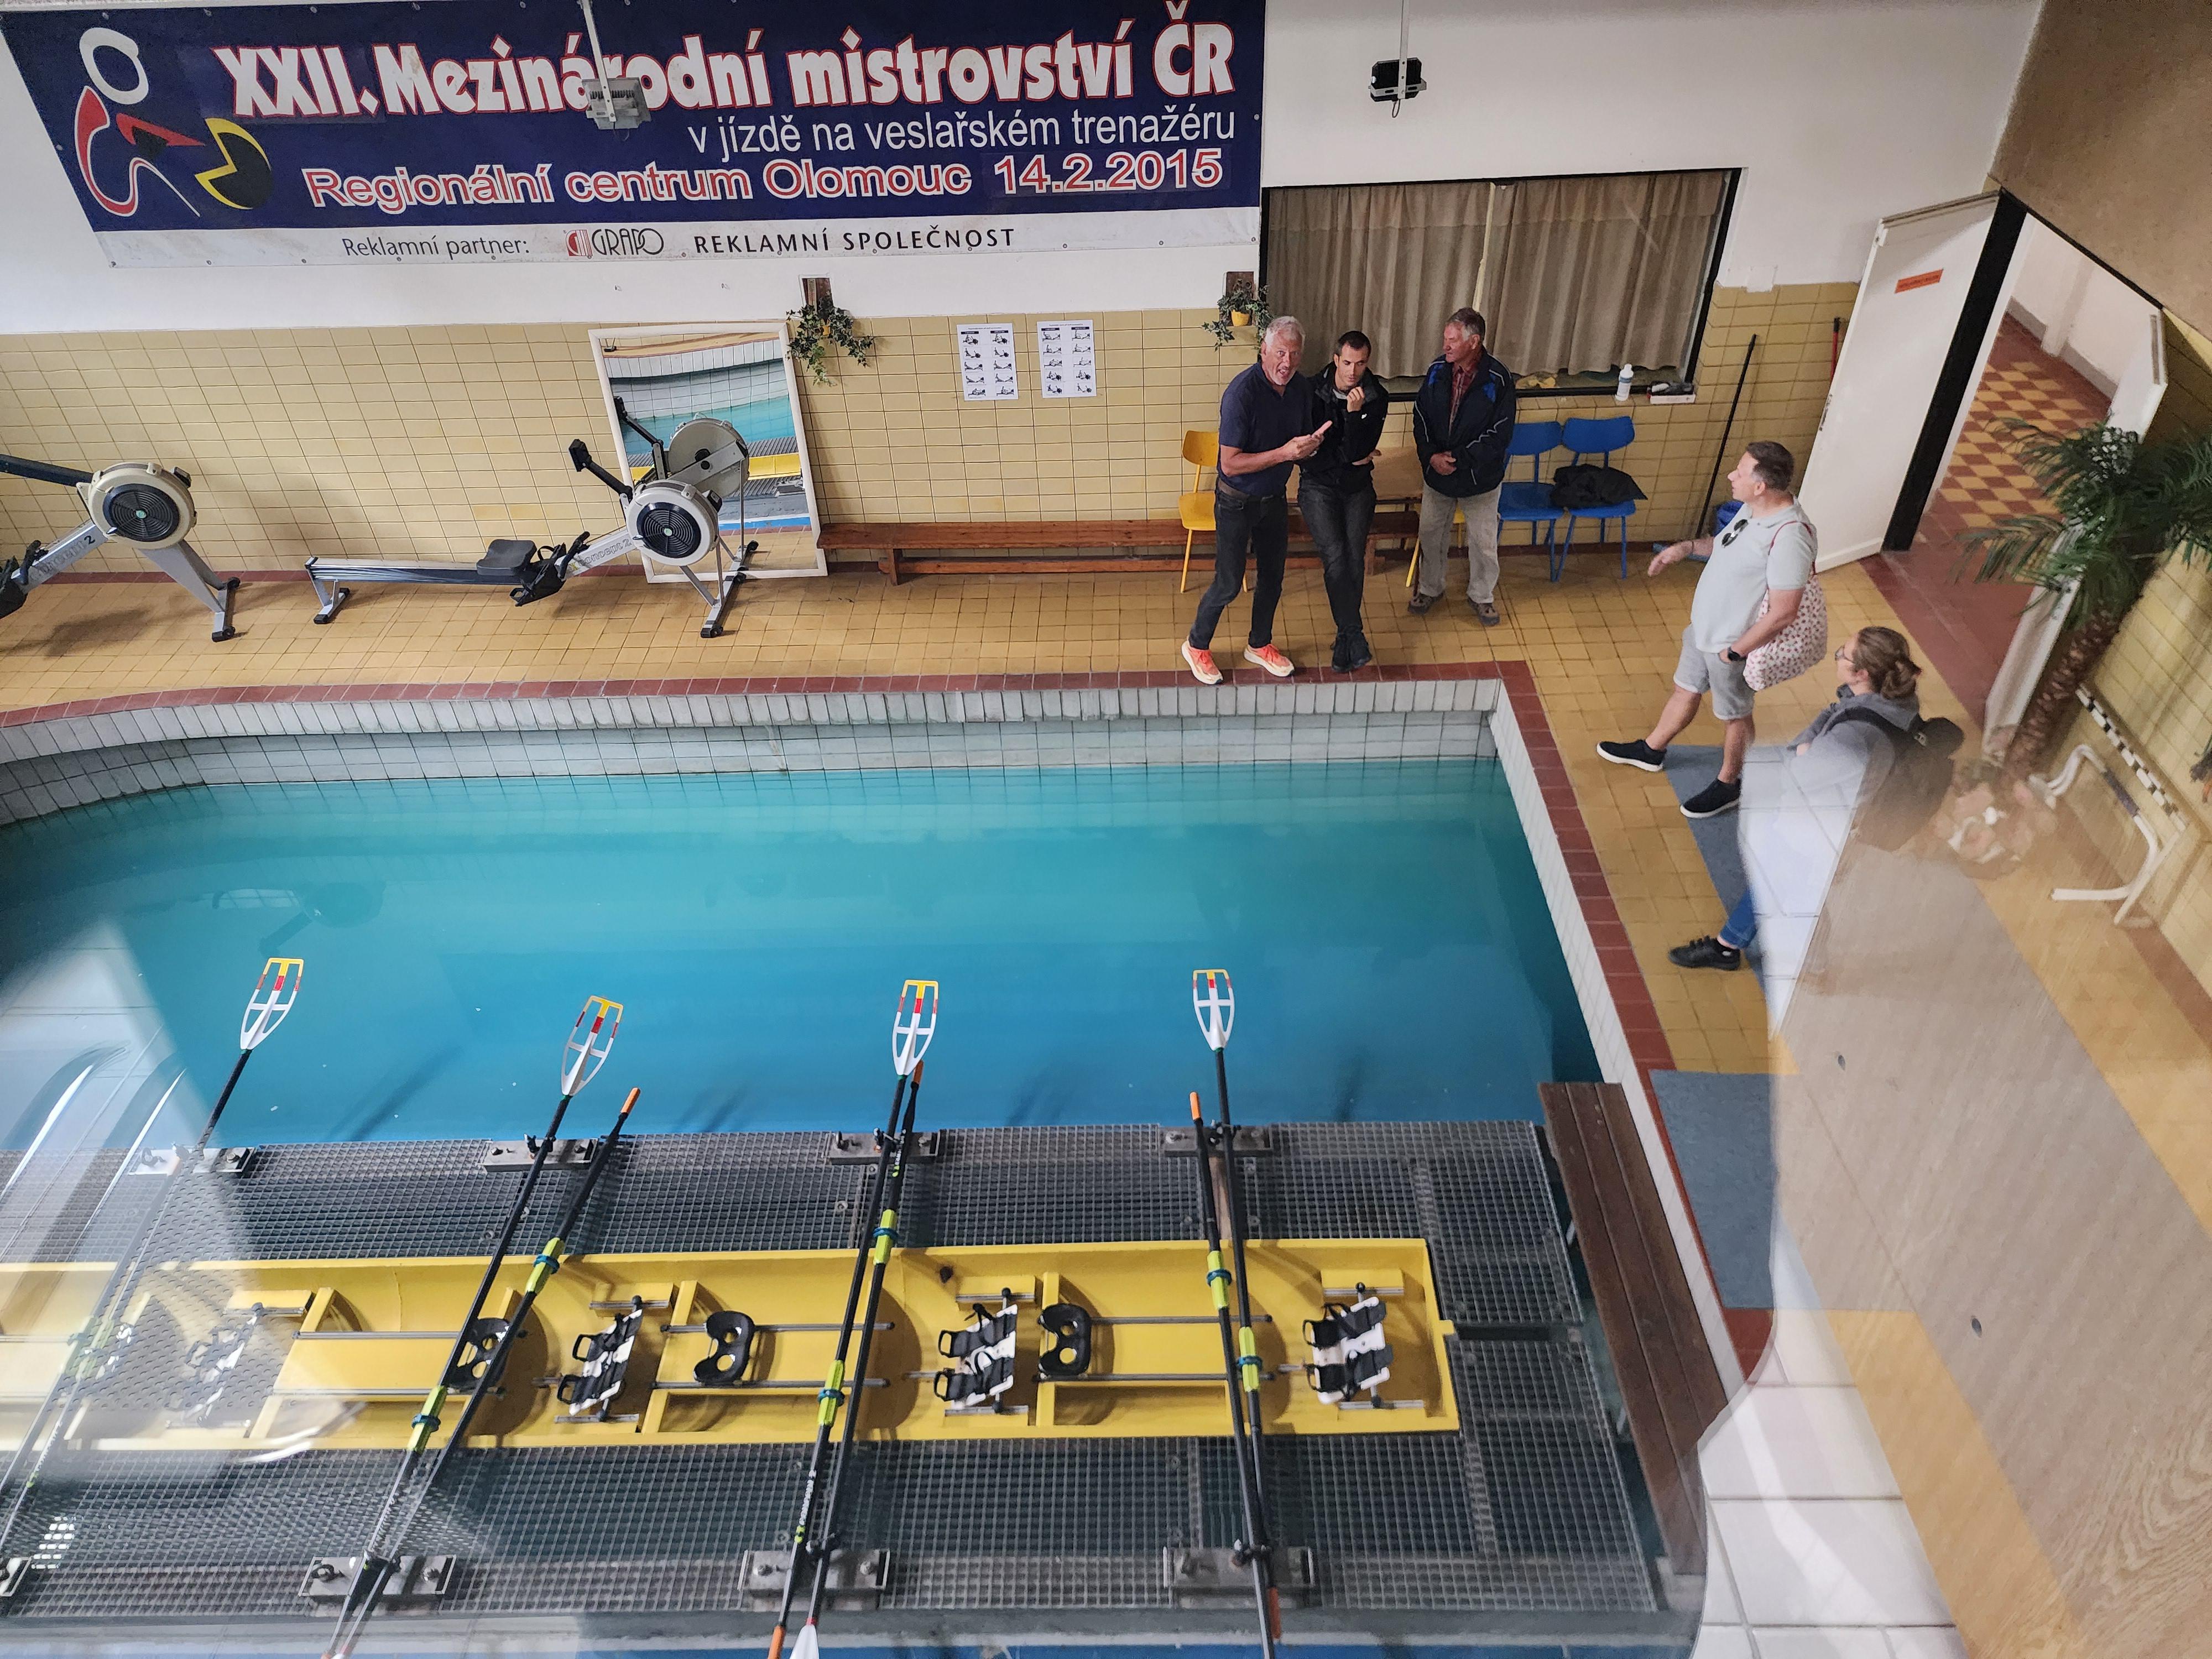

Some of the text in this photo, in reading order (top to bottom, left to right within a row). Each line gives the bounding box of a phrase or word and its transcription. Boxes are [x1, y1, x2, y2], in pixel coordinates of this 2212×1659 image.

[785, 19, 1135, 107] mistrovství
[1154, 0, 1235, 96] ČR
[688, 103, 1234, 163] v jízdě na veslařském trenažéru
[301, 147, 1223, 215] Regionální centrum Olomouc 14.2.2015
[342, 235, 529, 260] Reklamní partner:
[694, 225, 1014, 253] REKLAMNÍ SPOLEČNOST
[84, 535, 96, 545] 2
[578, 542, 623, 567] concept
